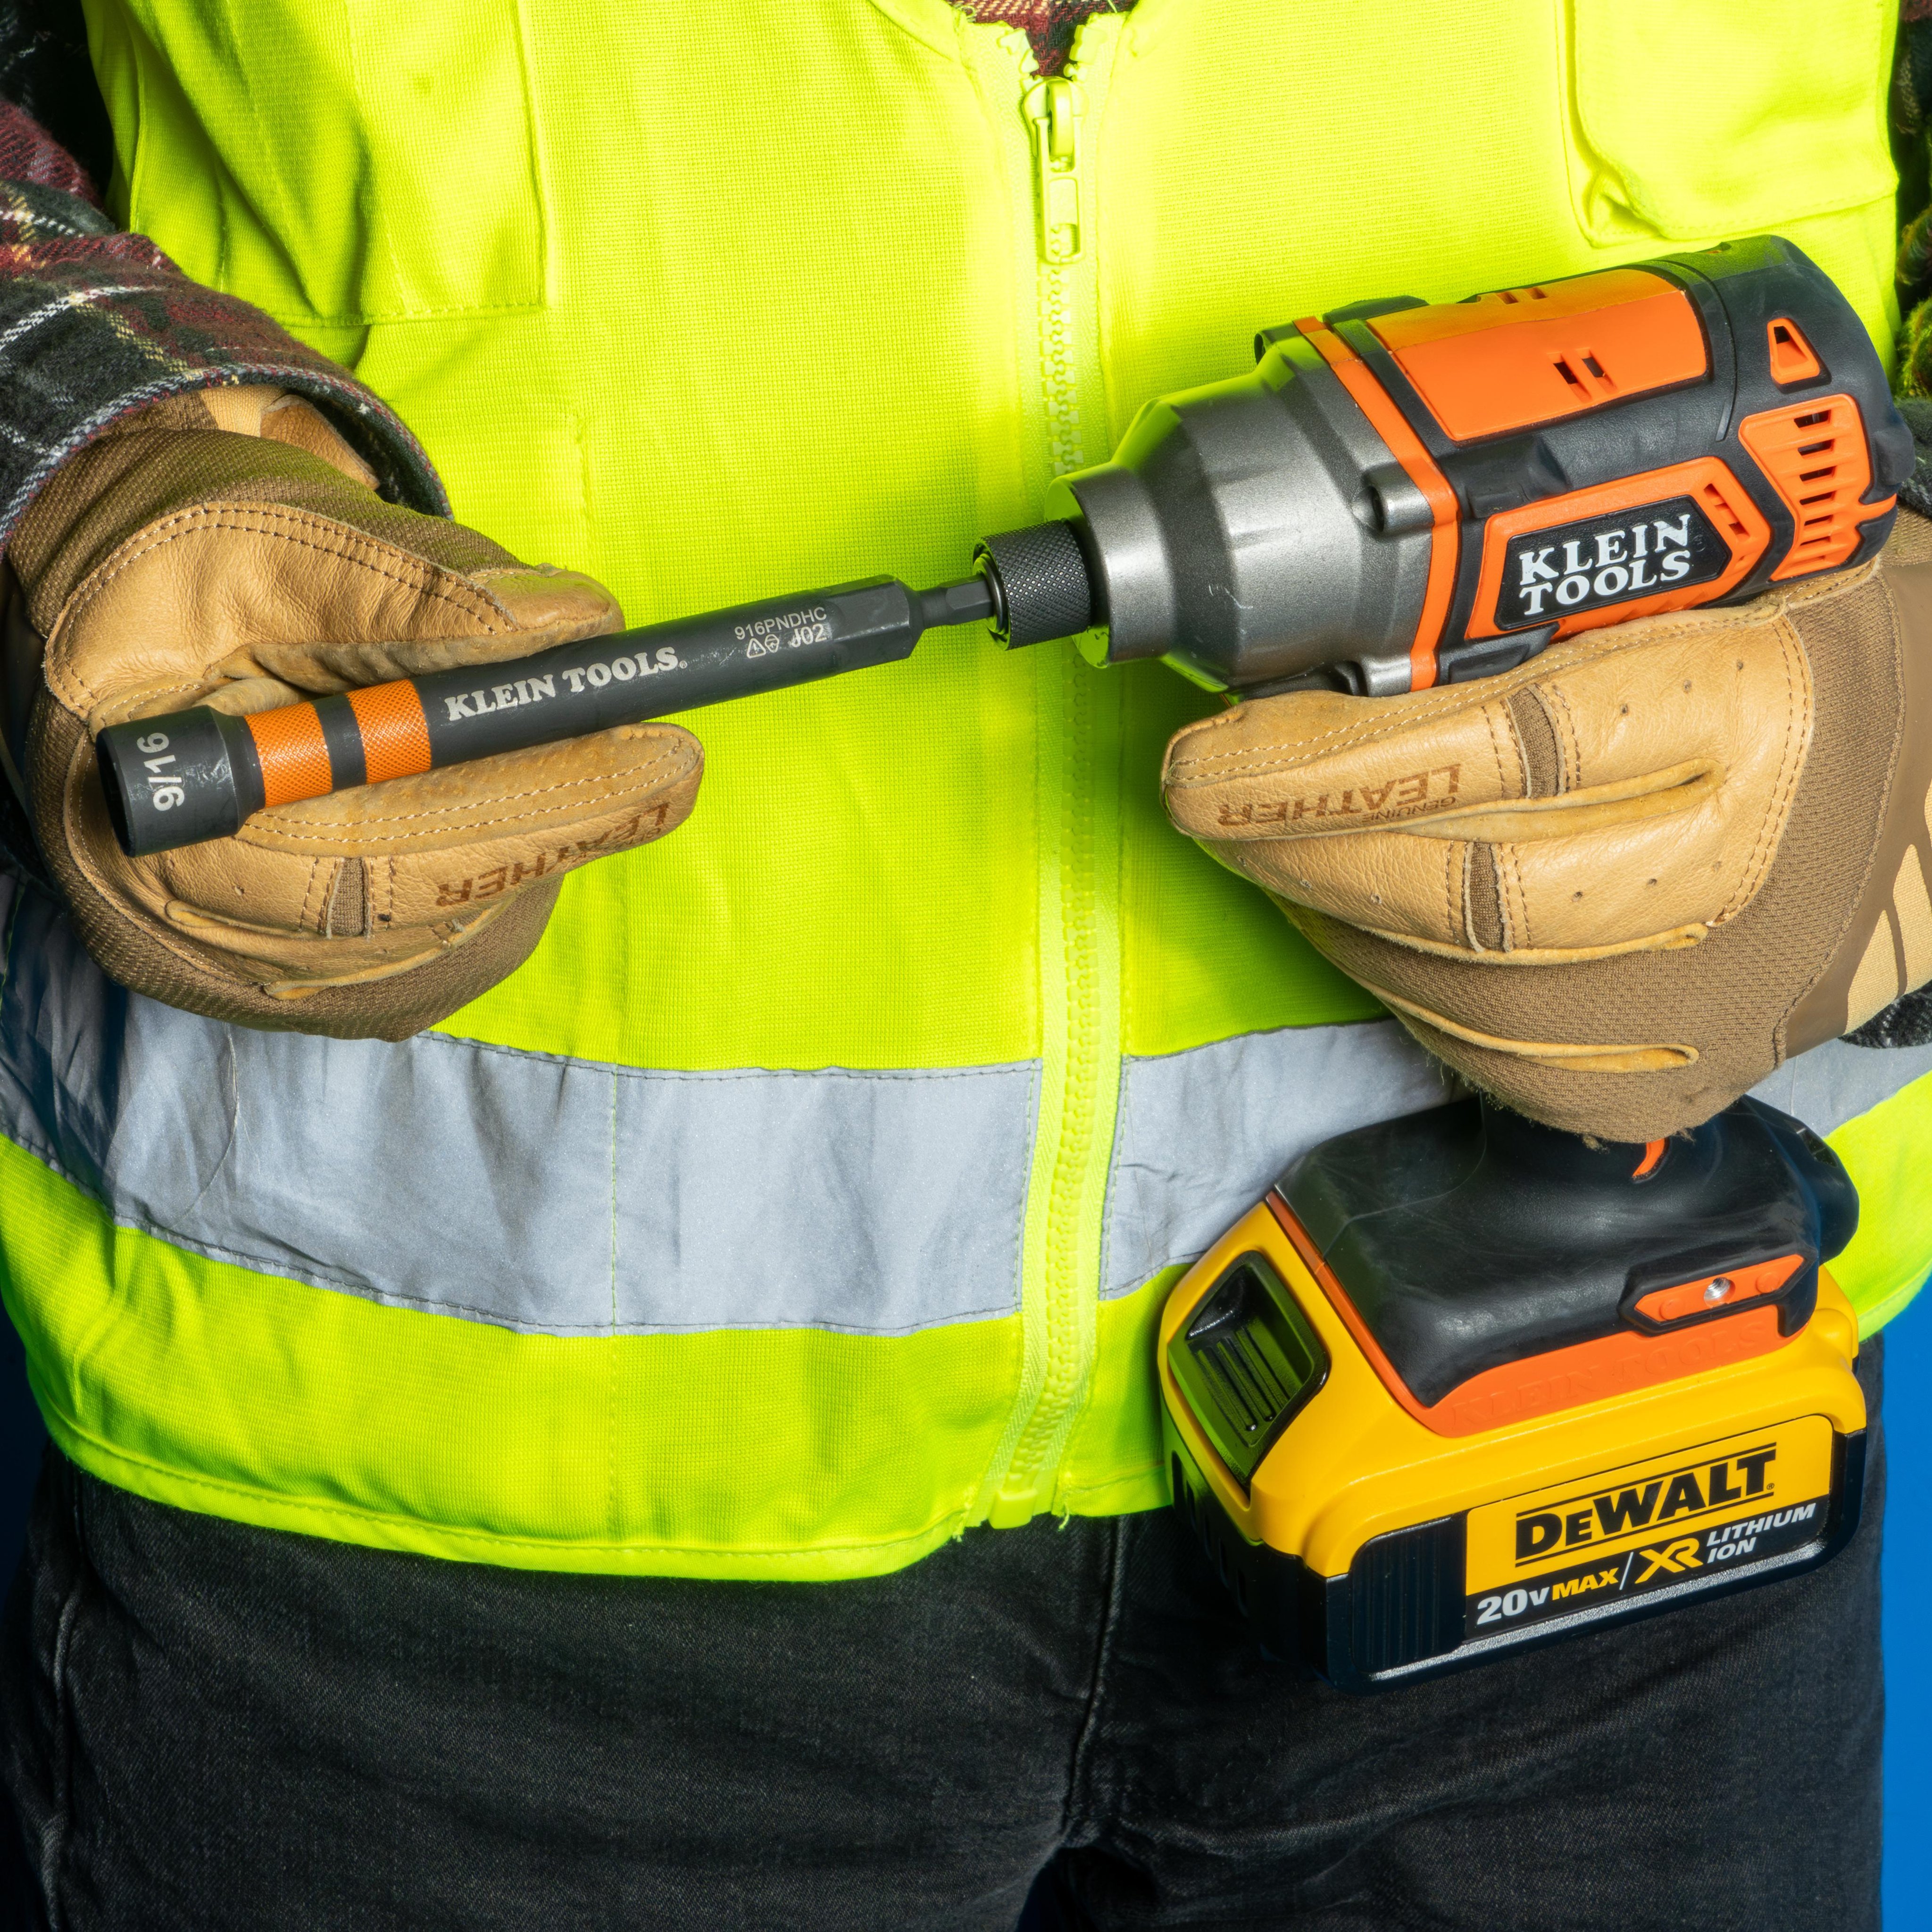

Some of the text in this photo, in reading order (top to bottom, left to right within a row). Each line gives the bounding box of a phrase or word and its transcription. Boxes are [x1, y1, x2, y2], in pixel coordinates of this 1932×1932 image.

[1519, 514, 1690, 585] KLEIN
[1519, 550, 1691, 616] TOOLS
[734, 607, 827, 640] 916PNDHC
[791, 623, 827, 648] J02
[444, 647, 678, 721] KLEIN TOOLS
[137, 733, 185, 811] 9/16
[1217, 764, 1461, 826] LEATHER
[1362, 796, 1457, 823] GENUINE
[1452, 1320, 1766, 1429] KLEIN TOOLS
[1706, 1503, 1816, 1547] LITHIUM
[1707, 1537, 1757, 1564] ION
[1634, 1538, 1703, 1584] XR
